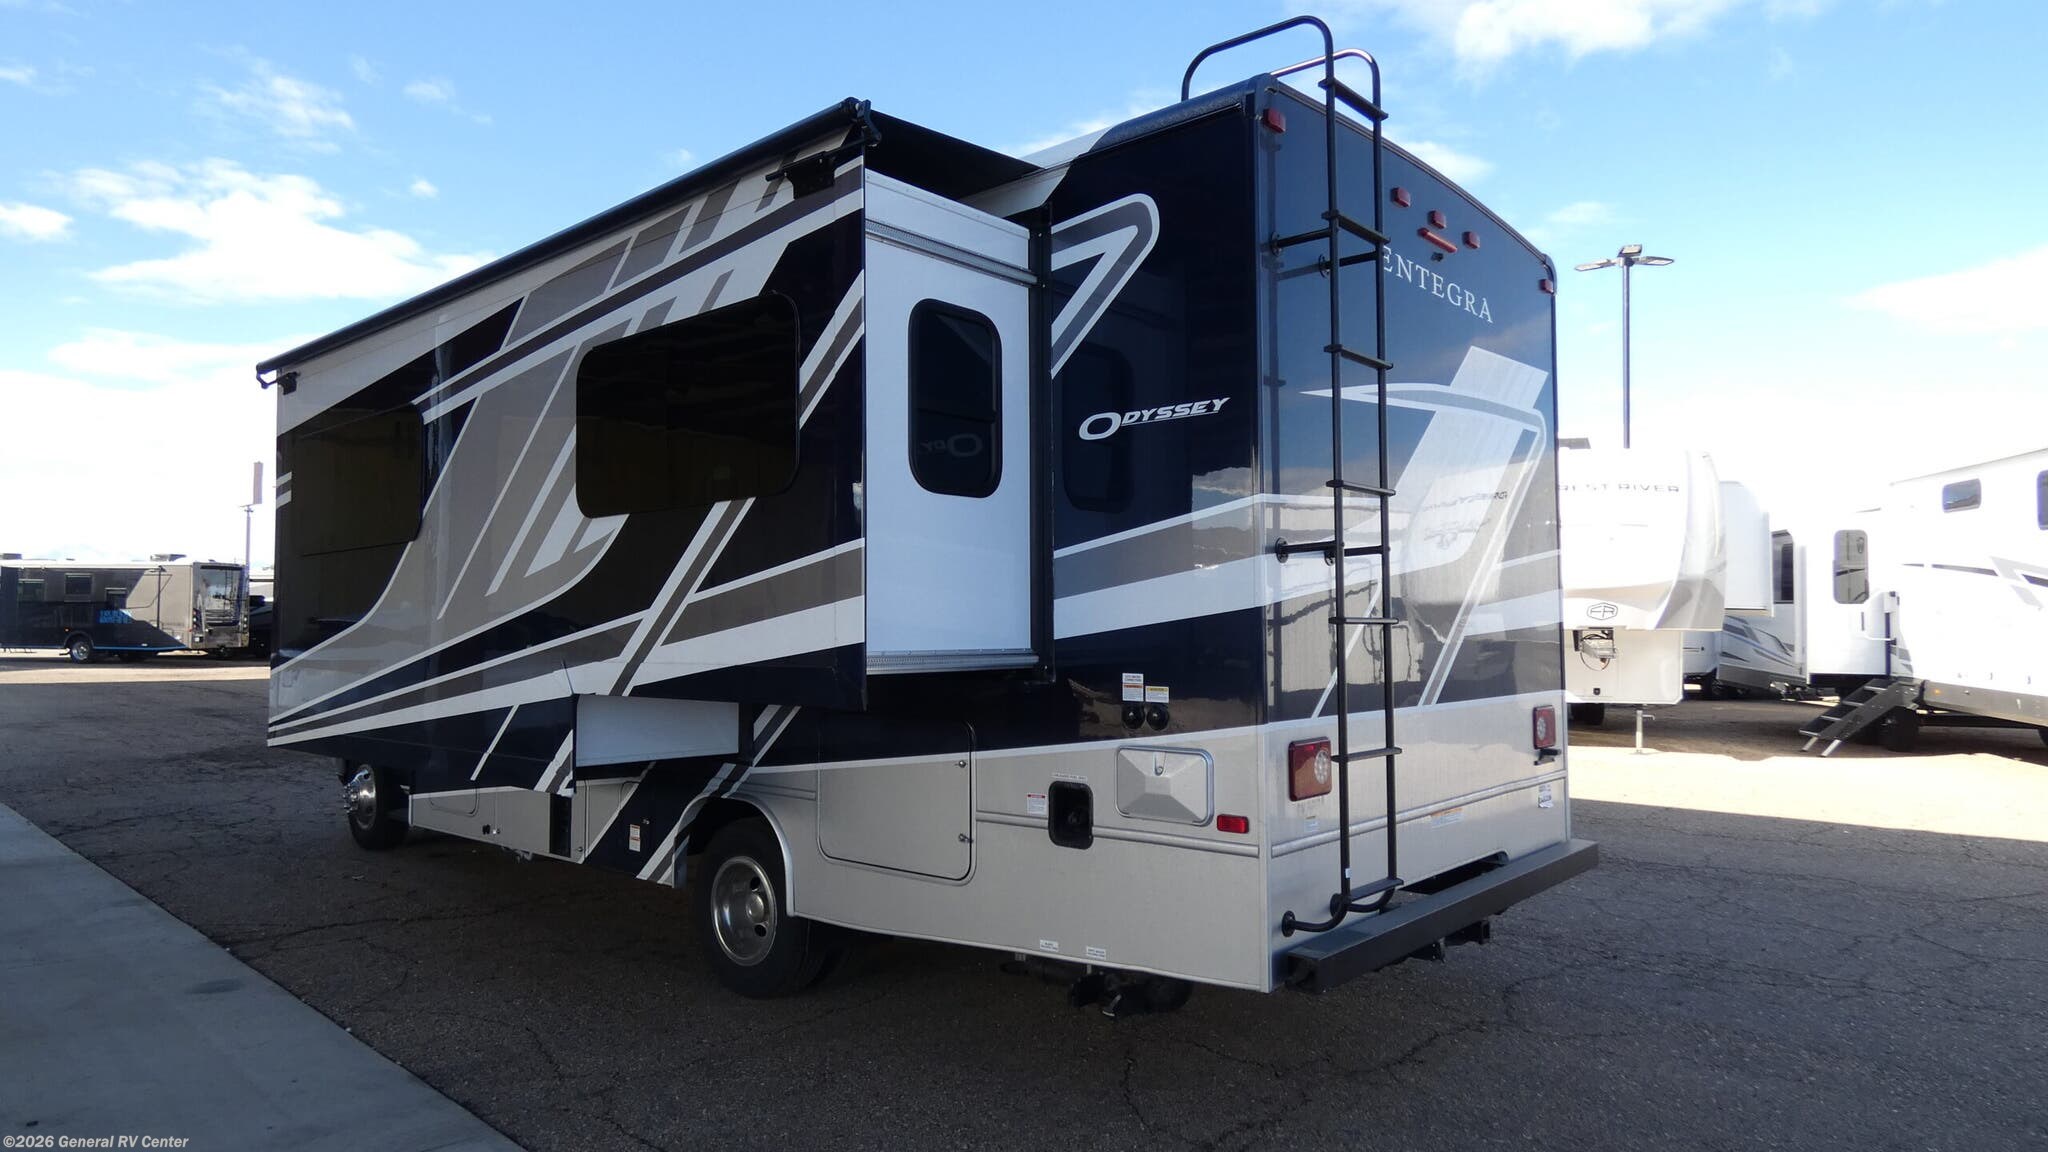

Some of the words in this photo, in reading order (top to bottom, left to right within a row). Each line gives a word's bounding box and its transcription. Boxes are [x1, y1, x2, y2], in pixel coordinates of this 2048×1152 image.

[1383, 245, 1494, 324] ENTEGRA
[1078, 397, 1231, 441] ODYSSEY
[1617, 483, 1680, 493] RIVER
